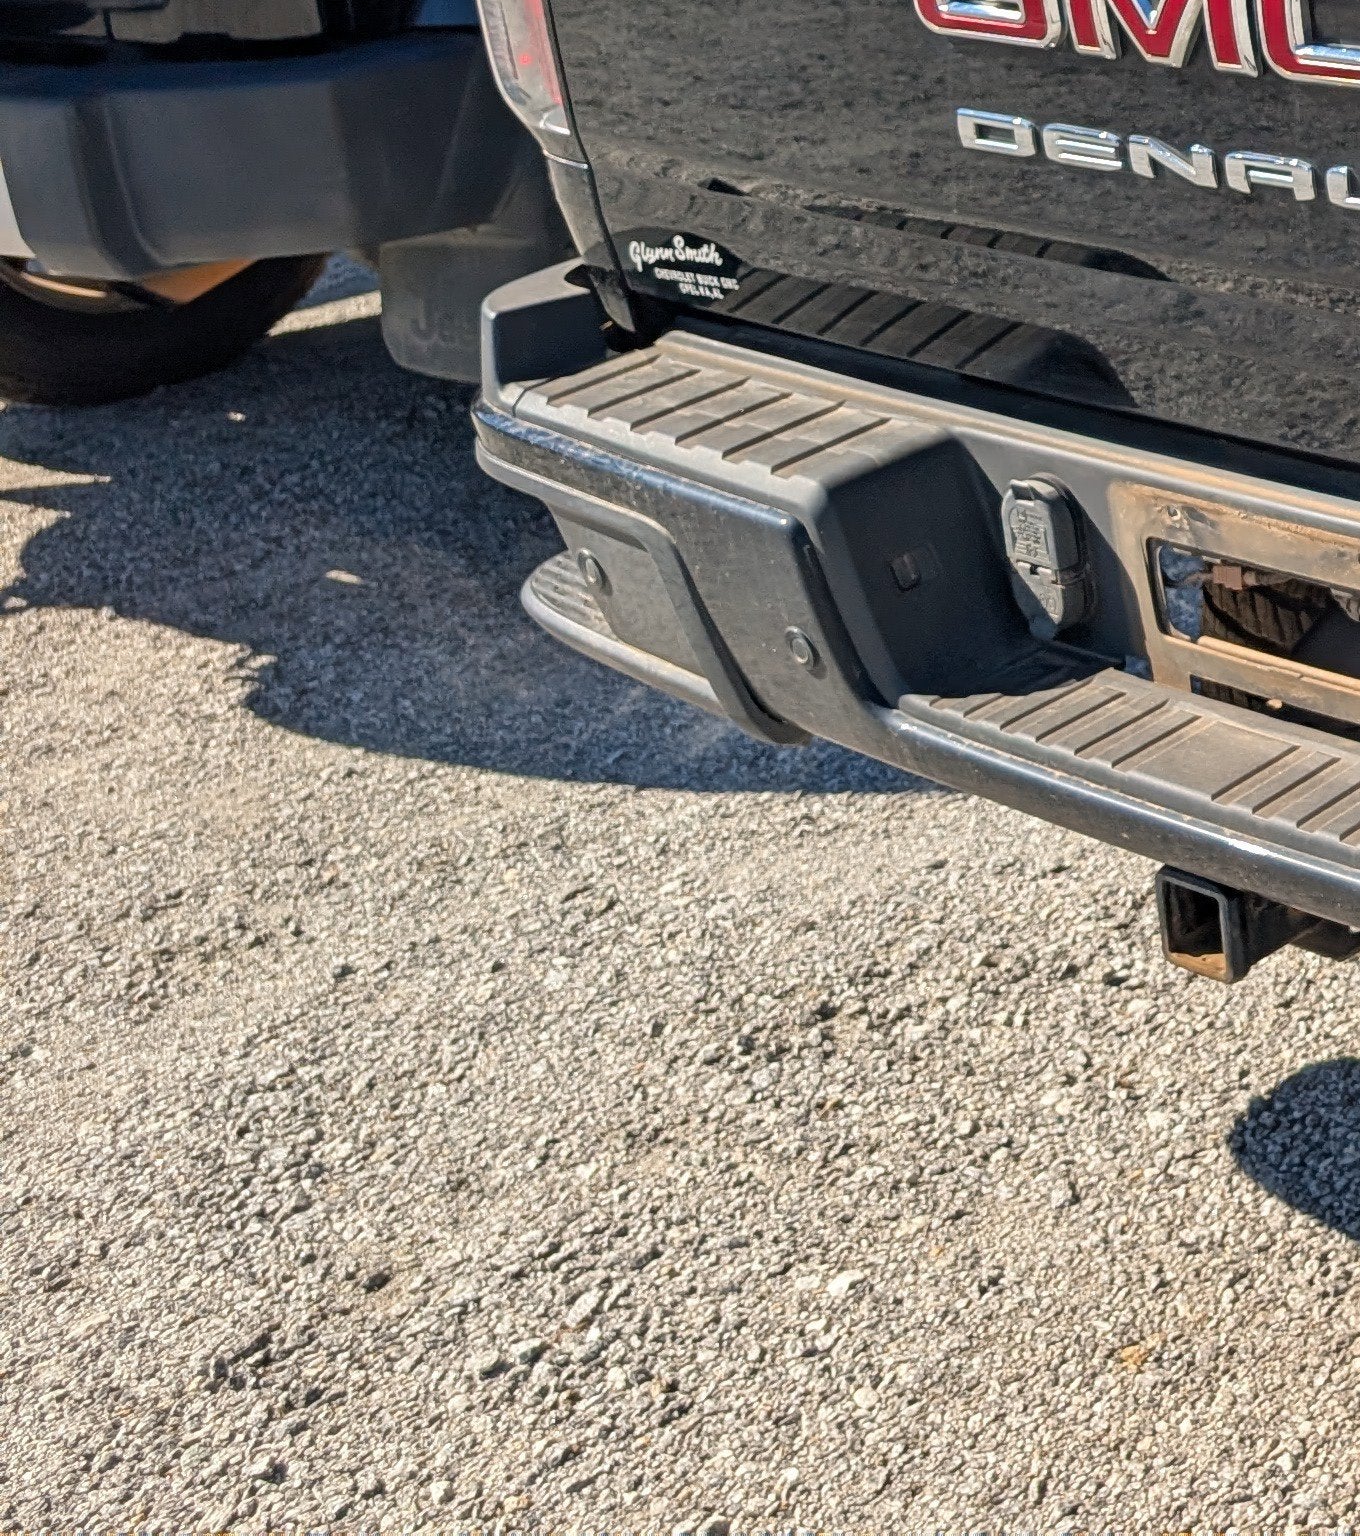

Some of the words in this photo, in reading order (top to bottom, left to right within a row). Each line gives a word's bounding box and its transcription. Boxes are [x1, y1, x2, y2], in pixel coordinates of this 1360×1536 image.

[629, 240, 676, 273] Glynn
[673, 234, 723, 267] Smith
[410, 296, 481, 345] Jee
